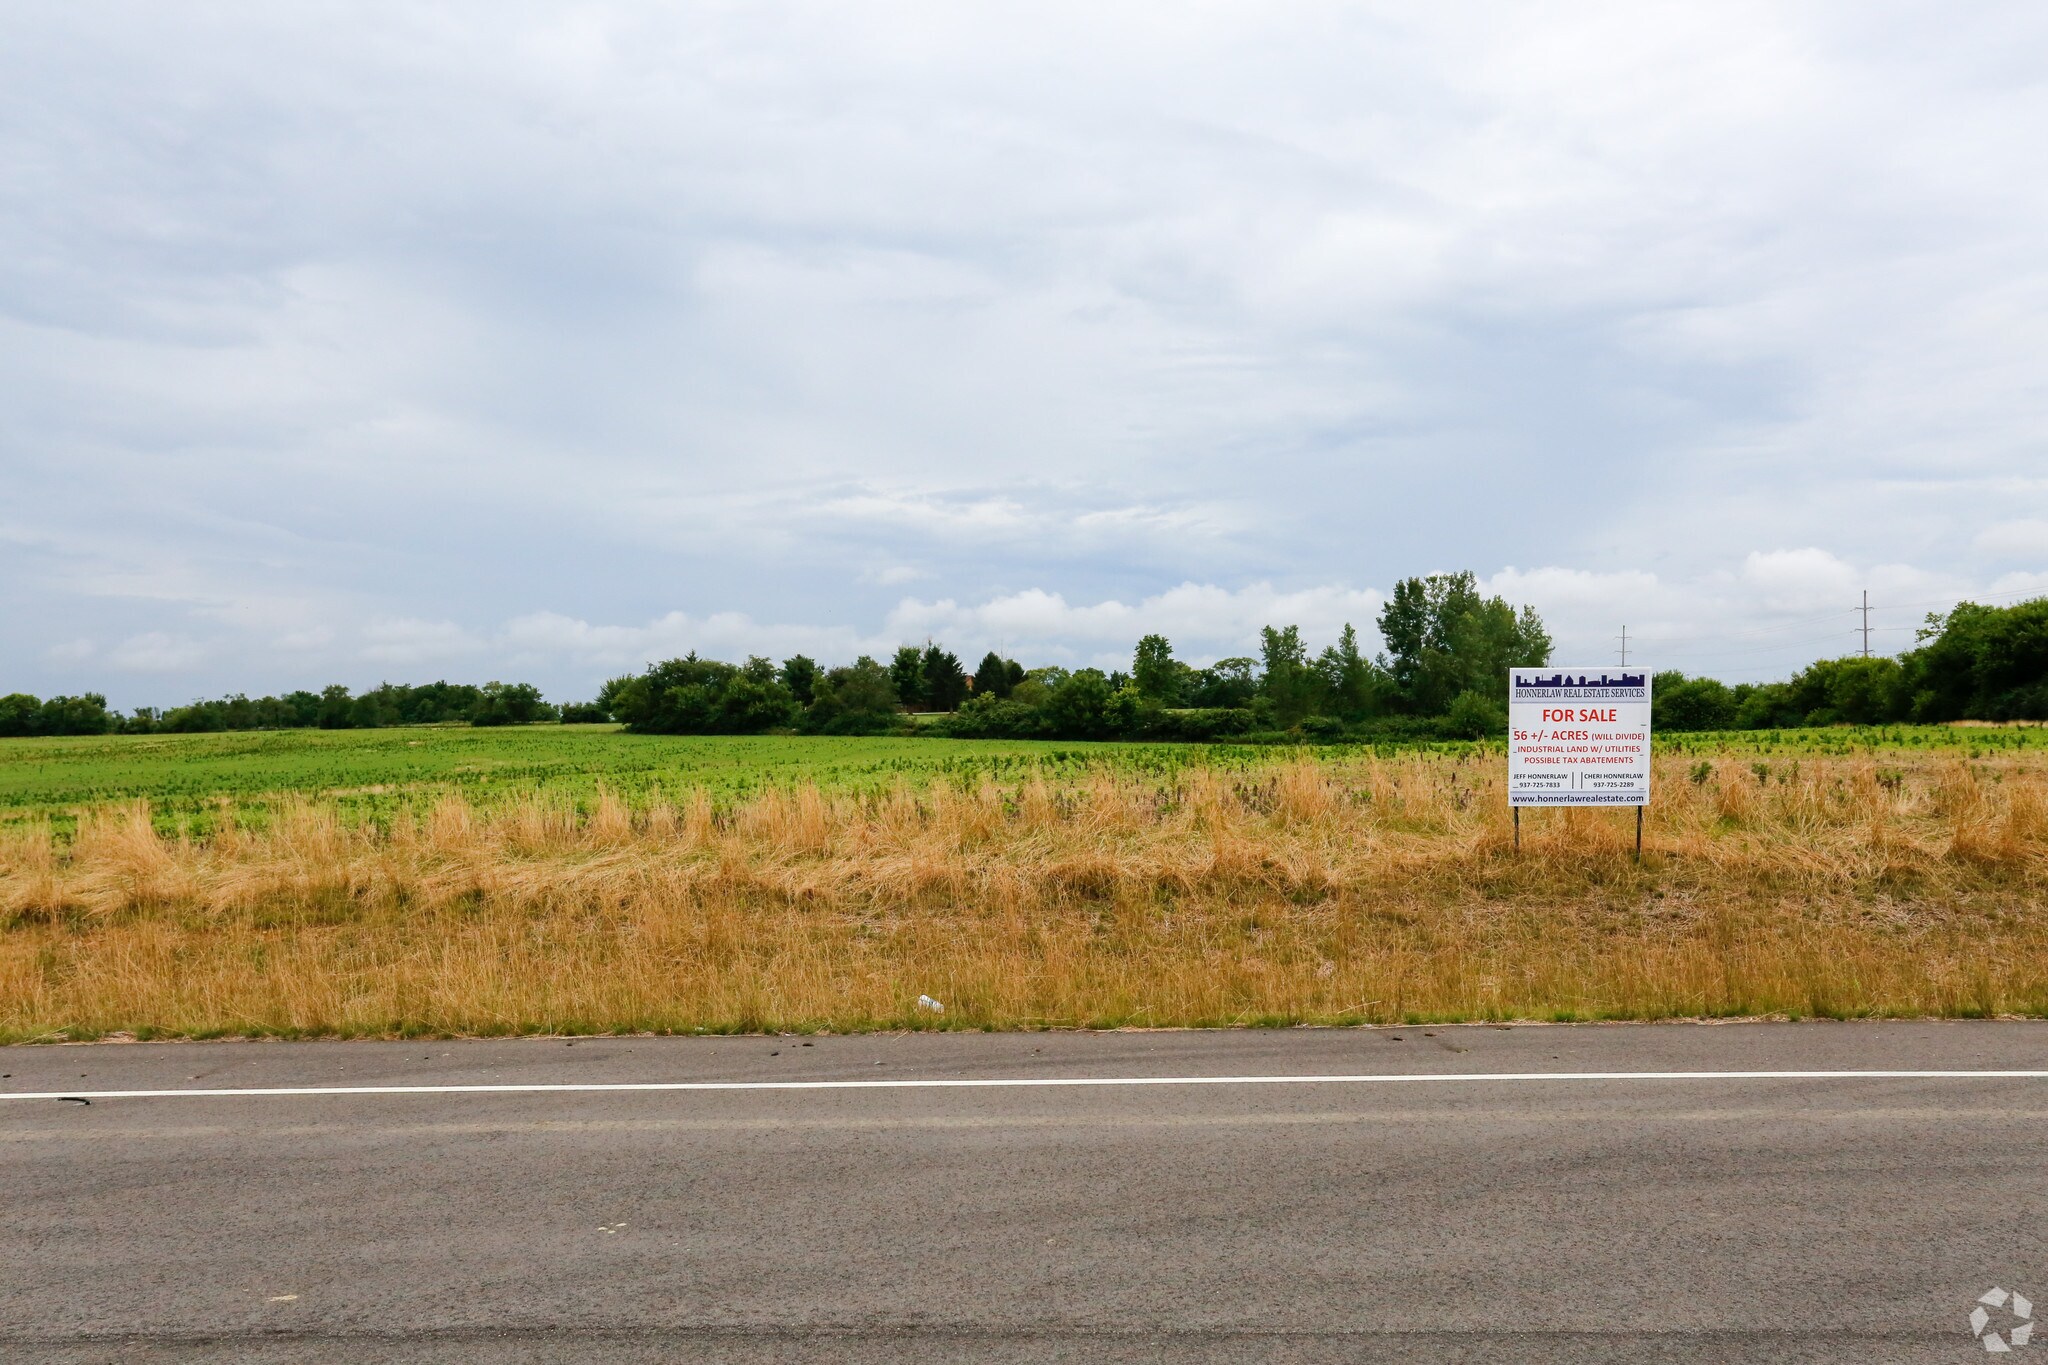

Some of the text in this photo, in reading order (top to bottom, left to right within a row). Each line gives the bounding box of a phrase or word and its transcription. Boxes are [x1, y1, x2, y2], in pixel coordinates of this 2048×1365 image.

[1515, 688, 1645, 698] HONNERLAW REAL ESTATE SERVICES
[1543, 709, 1617, 722] FOR SALE
[1513, 730, 1645, 742] 56 +/- ACRES (WILL DIVIDE)
[1512, 795, 1644, 803] www.honnerlawrealestate.com
